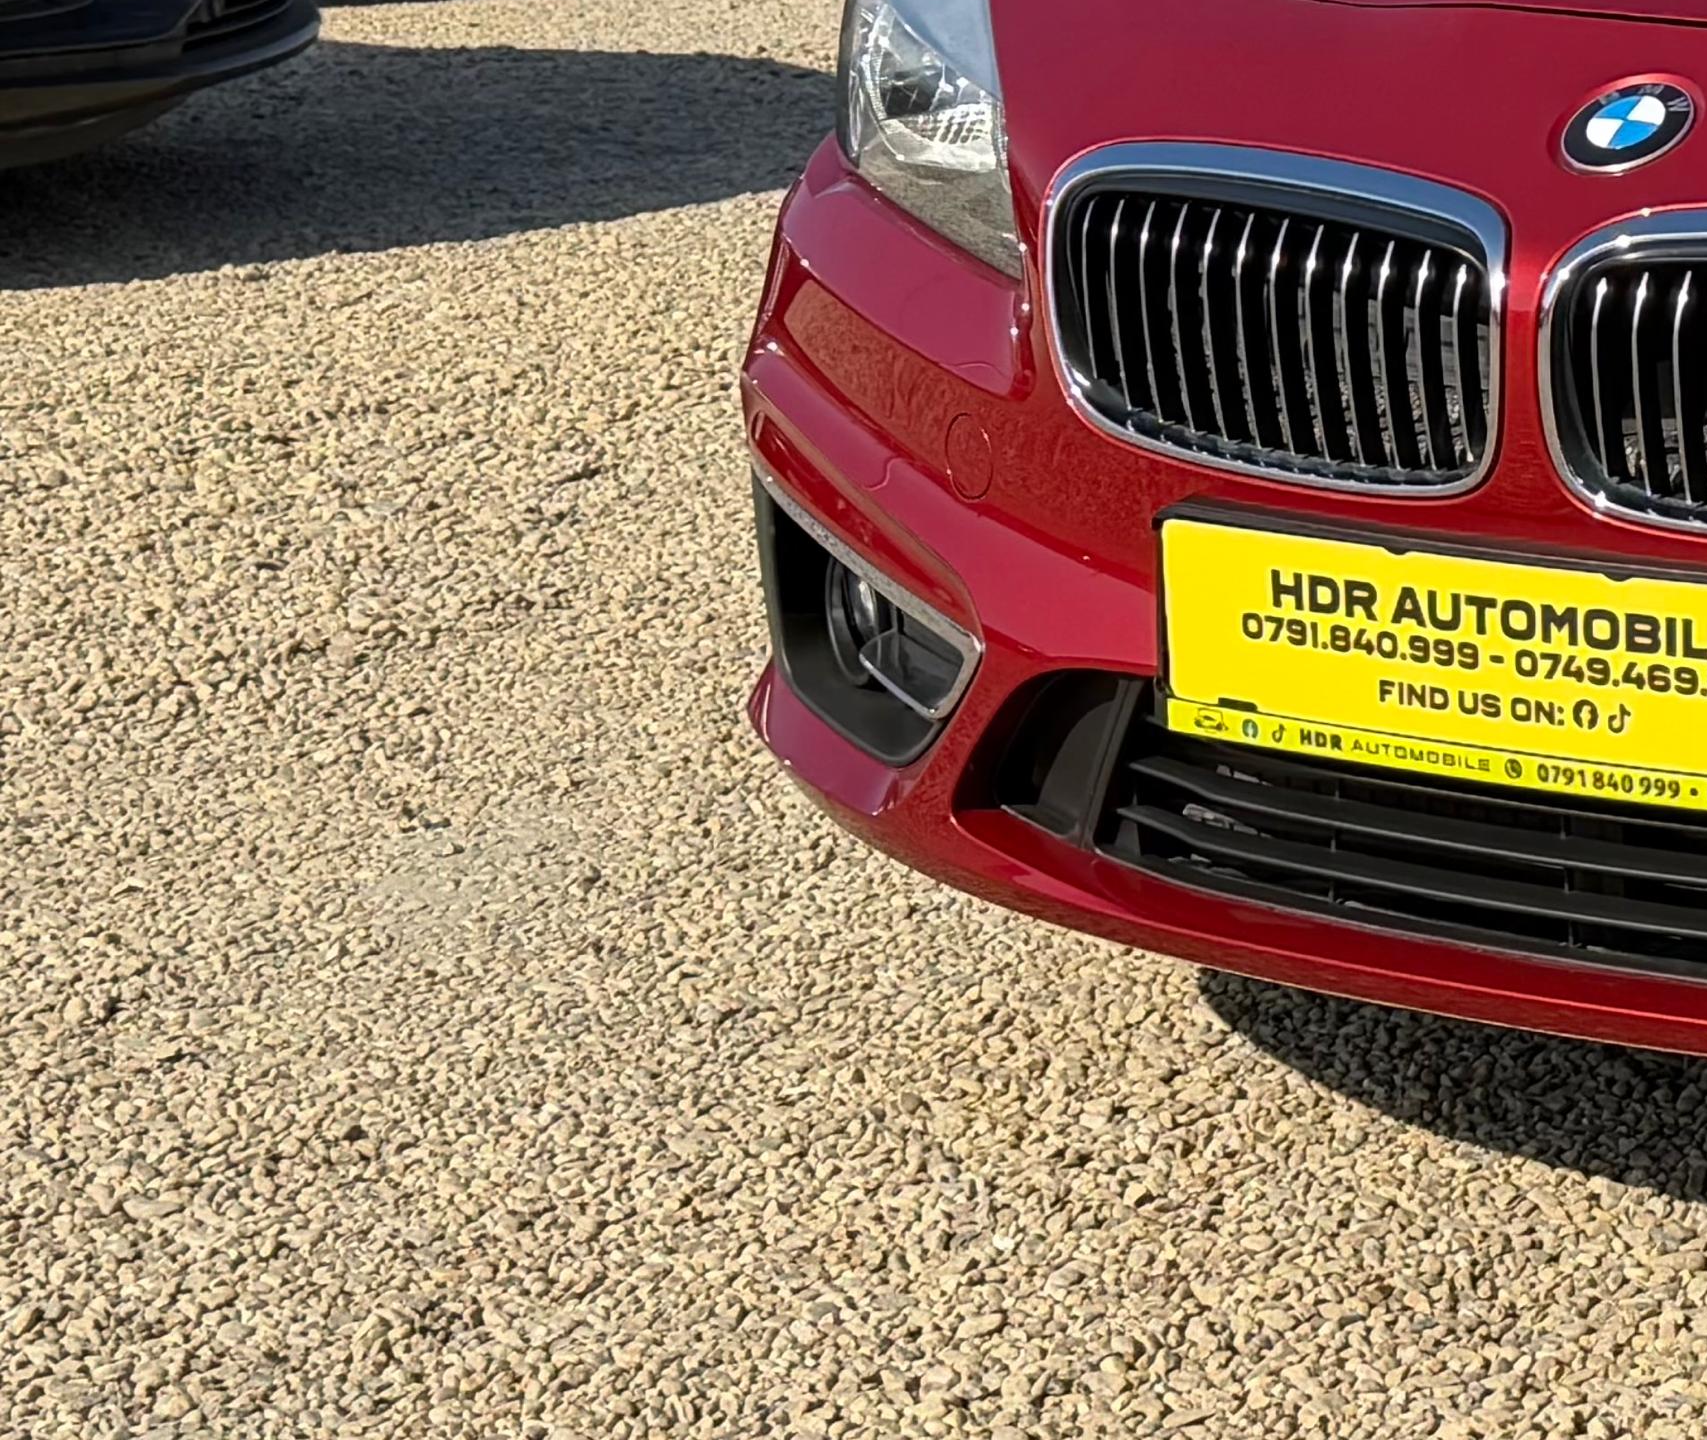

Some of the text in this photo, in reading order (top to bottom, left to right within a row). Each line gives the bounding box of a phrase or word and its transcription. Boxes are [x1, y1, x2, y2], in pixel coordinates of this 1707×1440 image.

[1271, 569, 1378, 622] HDR
[1242, 613, 1479, 670] 0791.840.999
[1378, 679, 1564, 726] FIND US ON:
[1299, 728, 1343, 751] HDR
[1351, 739, 1491, 772] AUTOMOBILE
[1537, 763, 1586, 787] 0791
[1591, 772, 1634, 793] 840
[1639, 776, 1681, 799] 999
